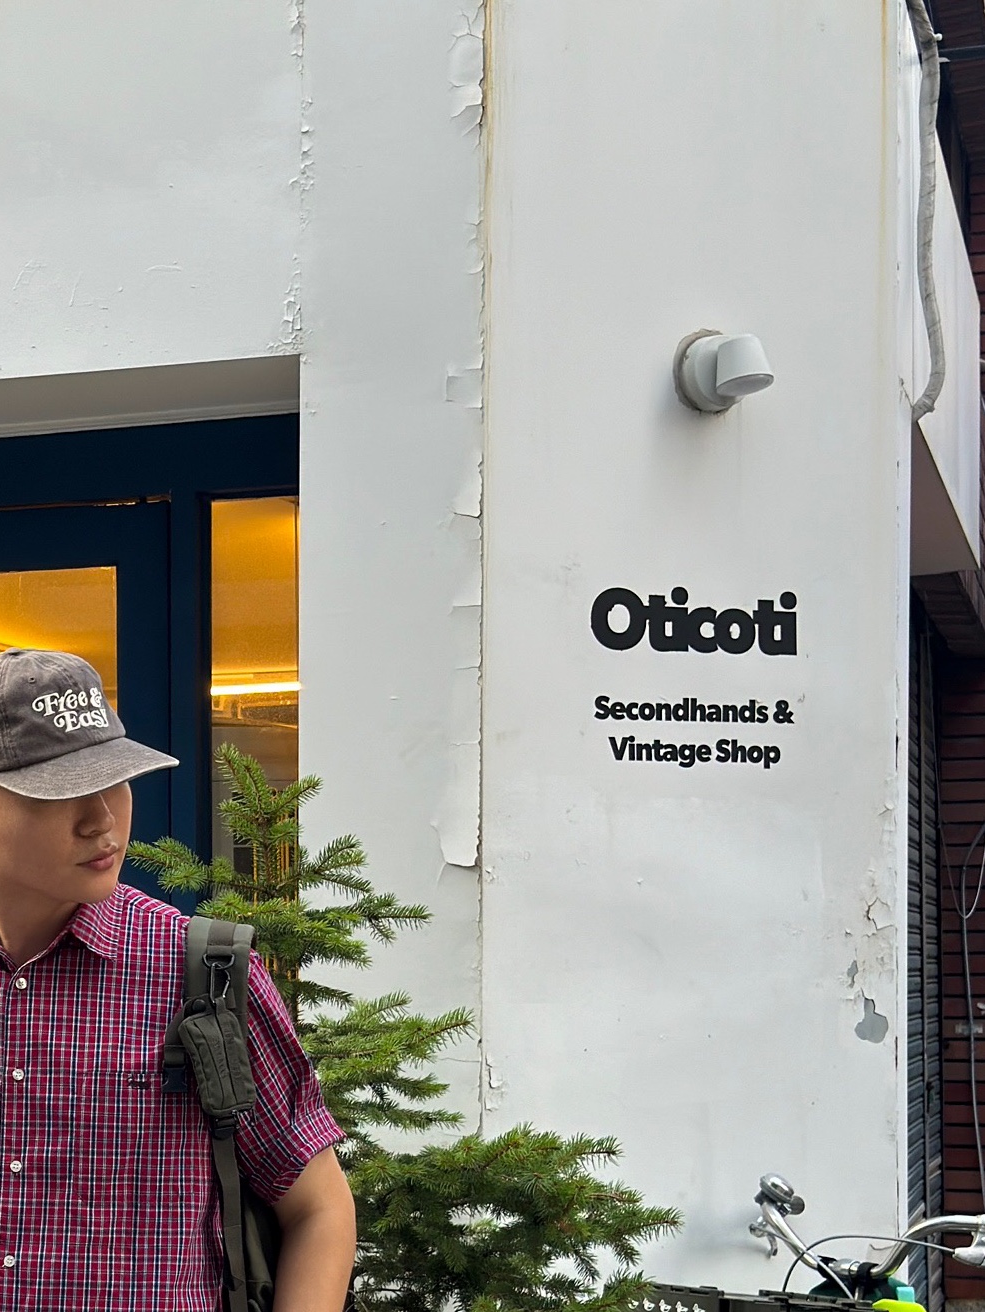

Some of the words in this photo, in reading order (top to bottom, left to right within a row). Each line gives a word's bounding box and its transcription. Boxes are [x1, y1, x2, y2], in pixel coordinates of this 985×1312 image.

[590, 586, 798, 656] Oticoti
[32, 688, 89, 717] Free
[89, 687, 103, 708] &
[594, 695, 769, 724] Secondhands
[773, 699, 795, 724] &
[609, 735, 712, 767] Vintage
[715, 739, 781, 769] Shop
